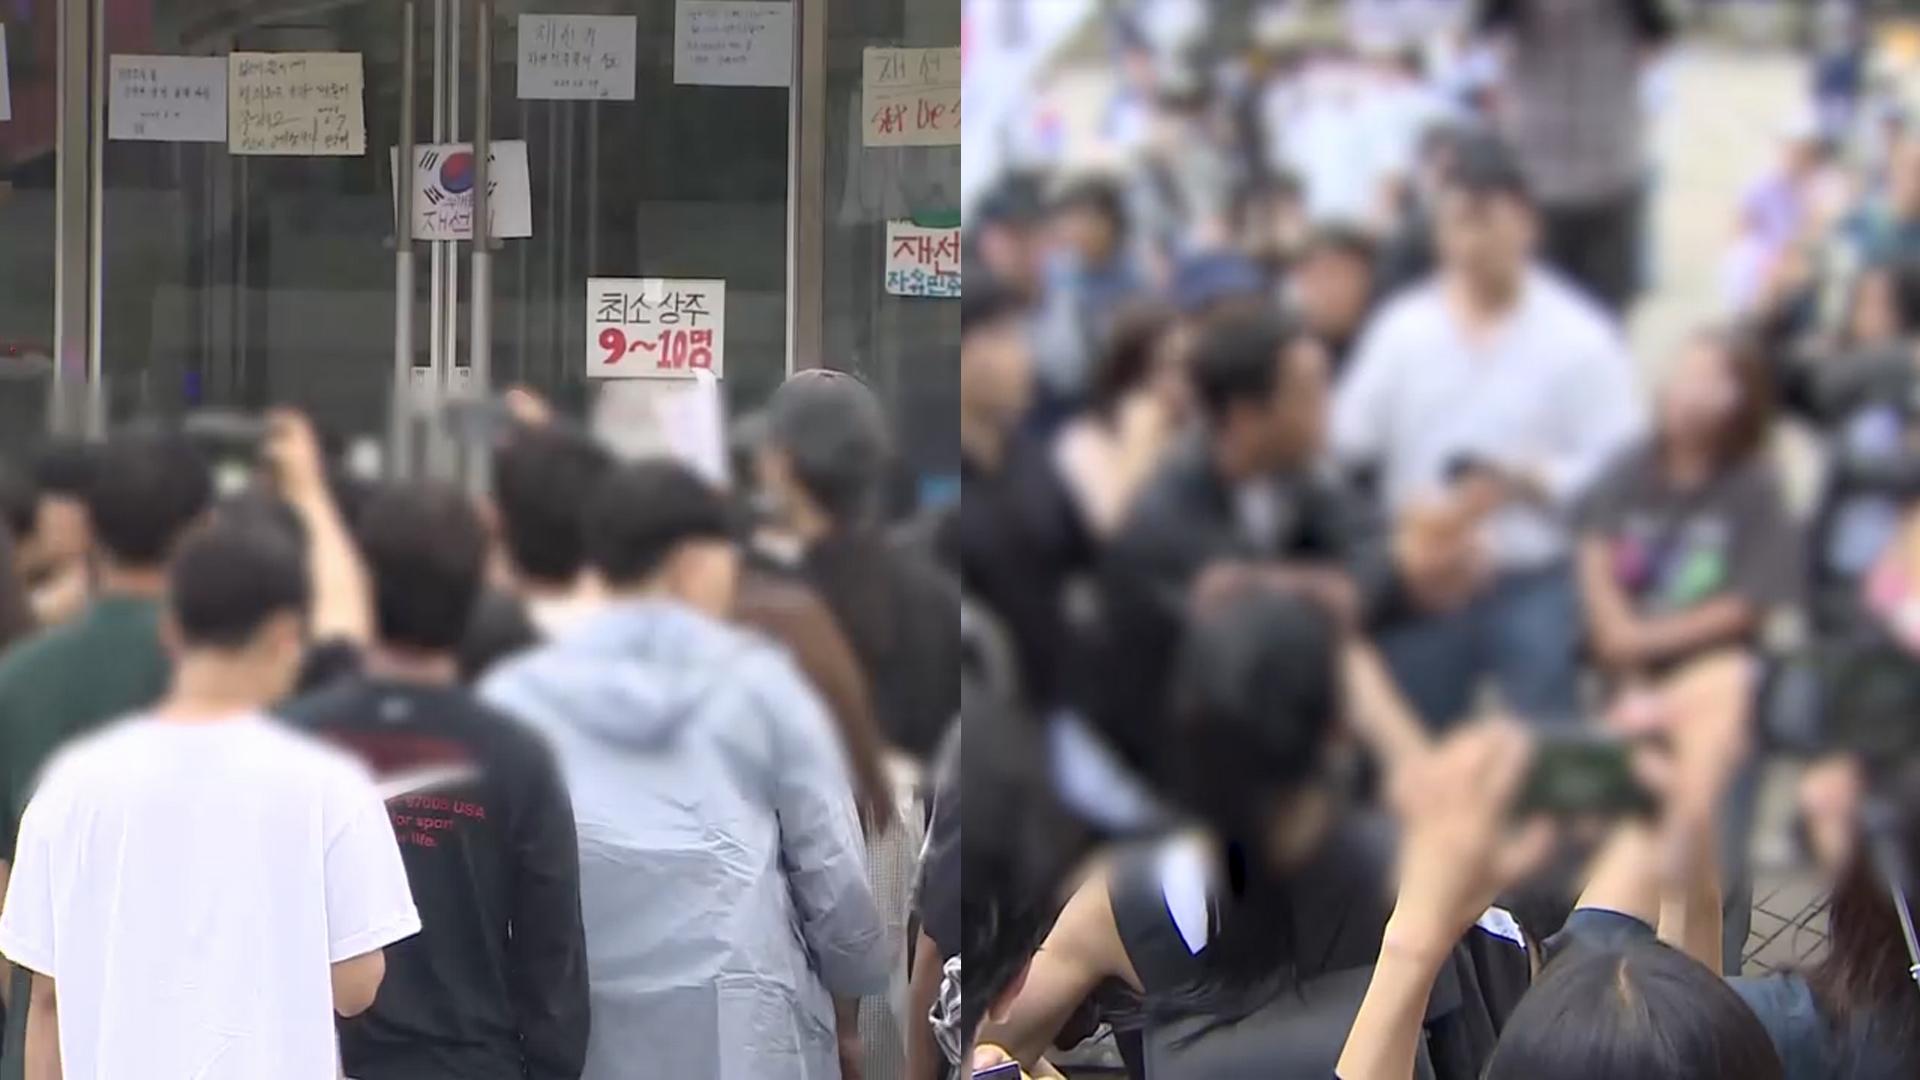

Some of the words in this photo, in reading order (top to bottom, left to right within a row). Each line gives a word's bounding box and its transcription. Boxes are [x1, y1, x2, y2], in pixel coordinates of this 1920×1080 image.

[596, 292, 651, 325] 최소
[658, 291, 709, 326] 상주
[599, 327, 712, 369] 9~10명
[453, 801, 486, 818] USA
